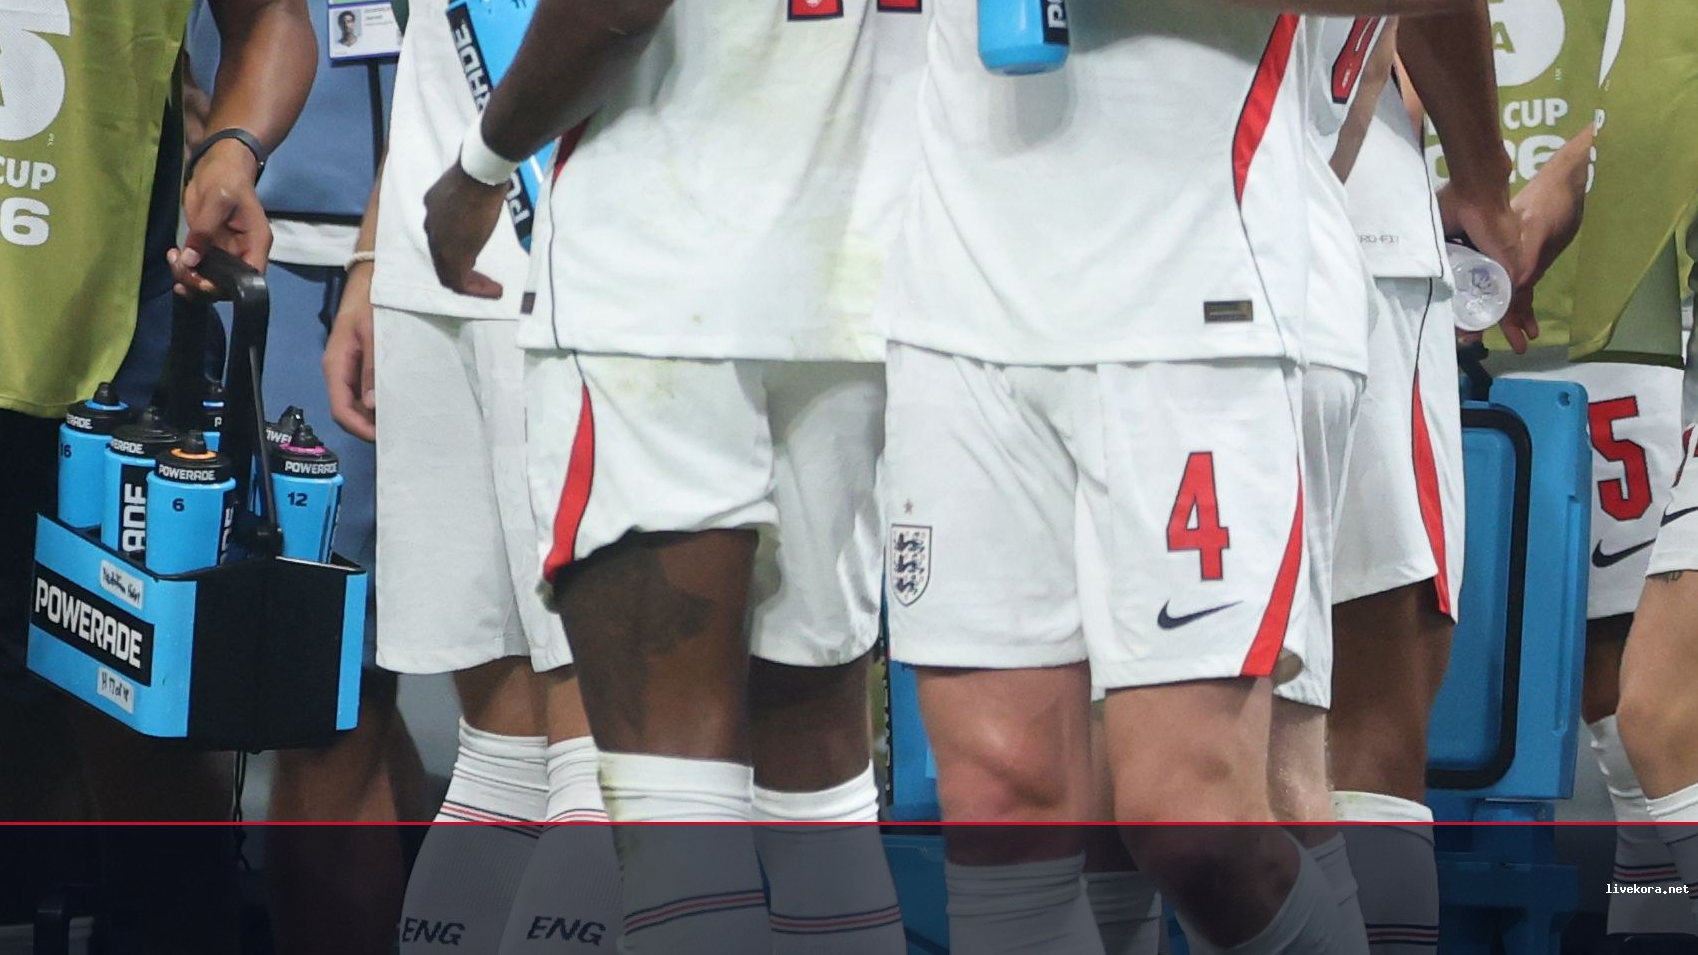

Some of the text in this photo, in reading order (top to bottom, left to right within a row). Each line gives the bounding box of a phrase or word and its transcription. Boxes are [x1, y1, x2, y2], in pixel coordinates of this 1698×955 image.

[1503, 98, 1568, 130] CUP
[159, 464, 216, 481] POWERADE
[285, 460, 338, 475] POWERADE
[1587, 395, 1653, 522] 5
[172, 498, 185, 512] 6
[287, 492, 308, 507] 12
[1166, 451, 1230, 580] 4
[35, 576, 143, 669] POWERADE
[403, 917, 465, 945] ENG
[527, 916, 606, 946] ENG
